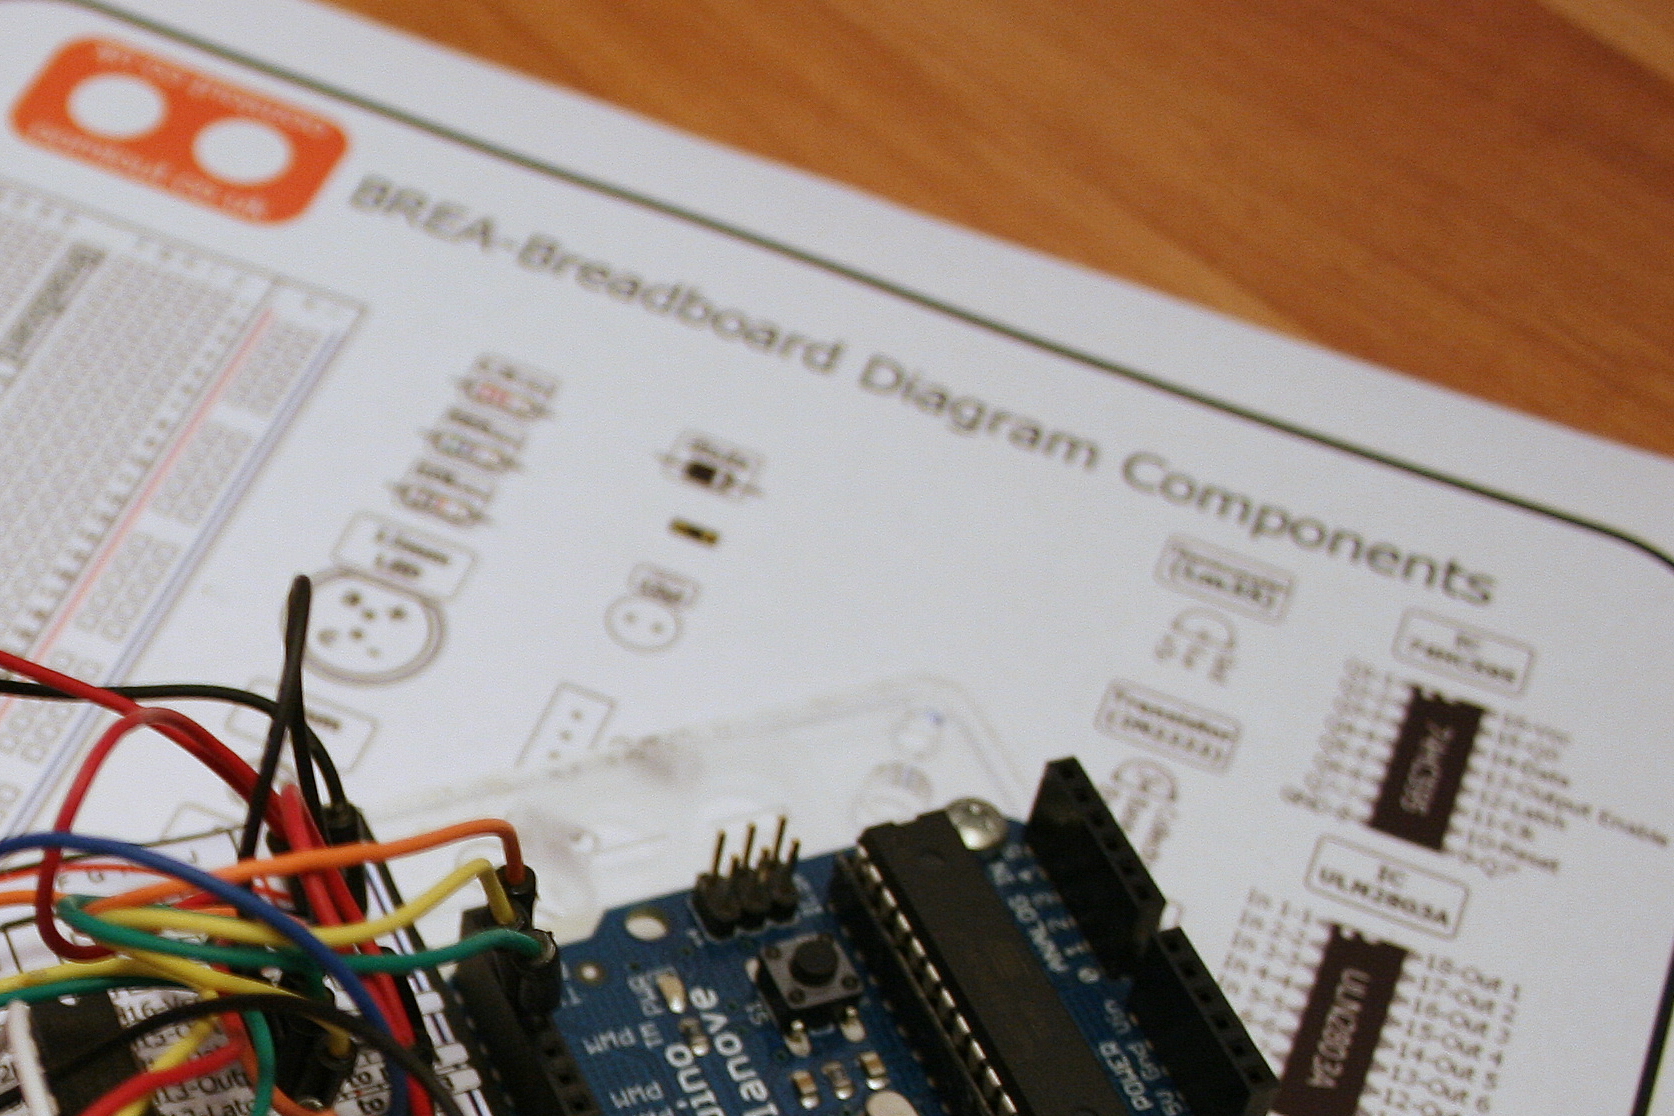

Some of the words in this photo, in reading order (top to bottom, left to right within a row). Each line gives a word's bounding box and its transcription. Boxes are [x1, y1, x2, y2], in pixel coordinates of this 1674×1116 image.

[349, 174, 845, 374] BREA-Breadboard
[860, 354, 1101, 474] Diagram
[1122, 452, 1498, 607] Components
[1098, 1039, 1153, 1112] POWER
